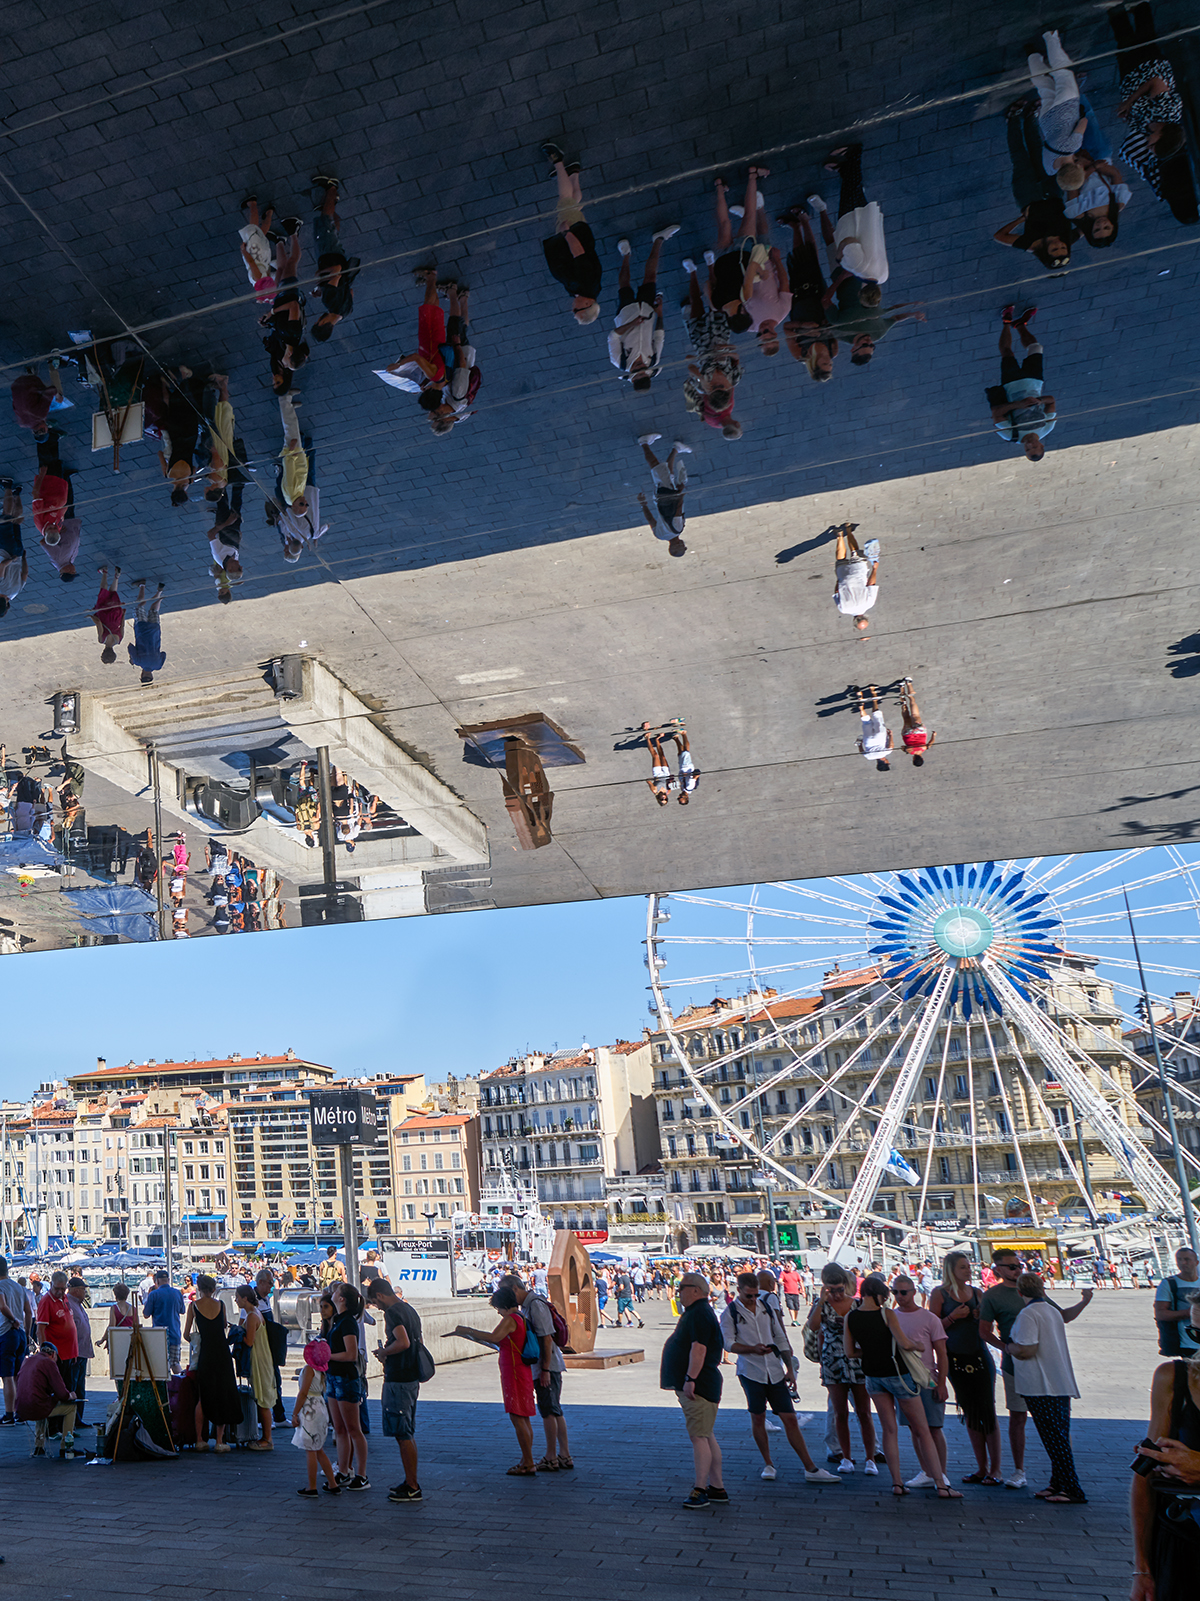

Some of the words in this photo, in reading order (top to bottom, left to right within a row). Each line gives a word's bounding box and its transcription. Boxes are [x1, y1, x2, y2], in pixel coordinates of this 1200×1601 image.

[313, 1106, 357, 1125] Métro
[396, 1240, 433, 1248] Vieux-Port
[399, 1269, 438, 1281] RTM
